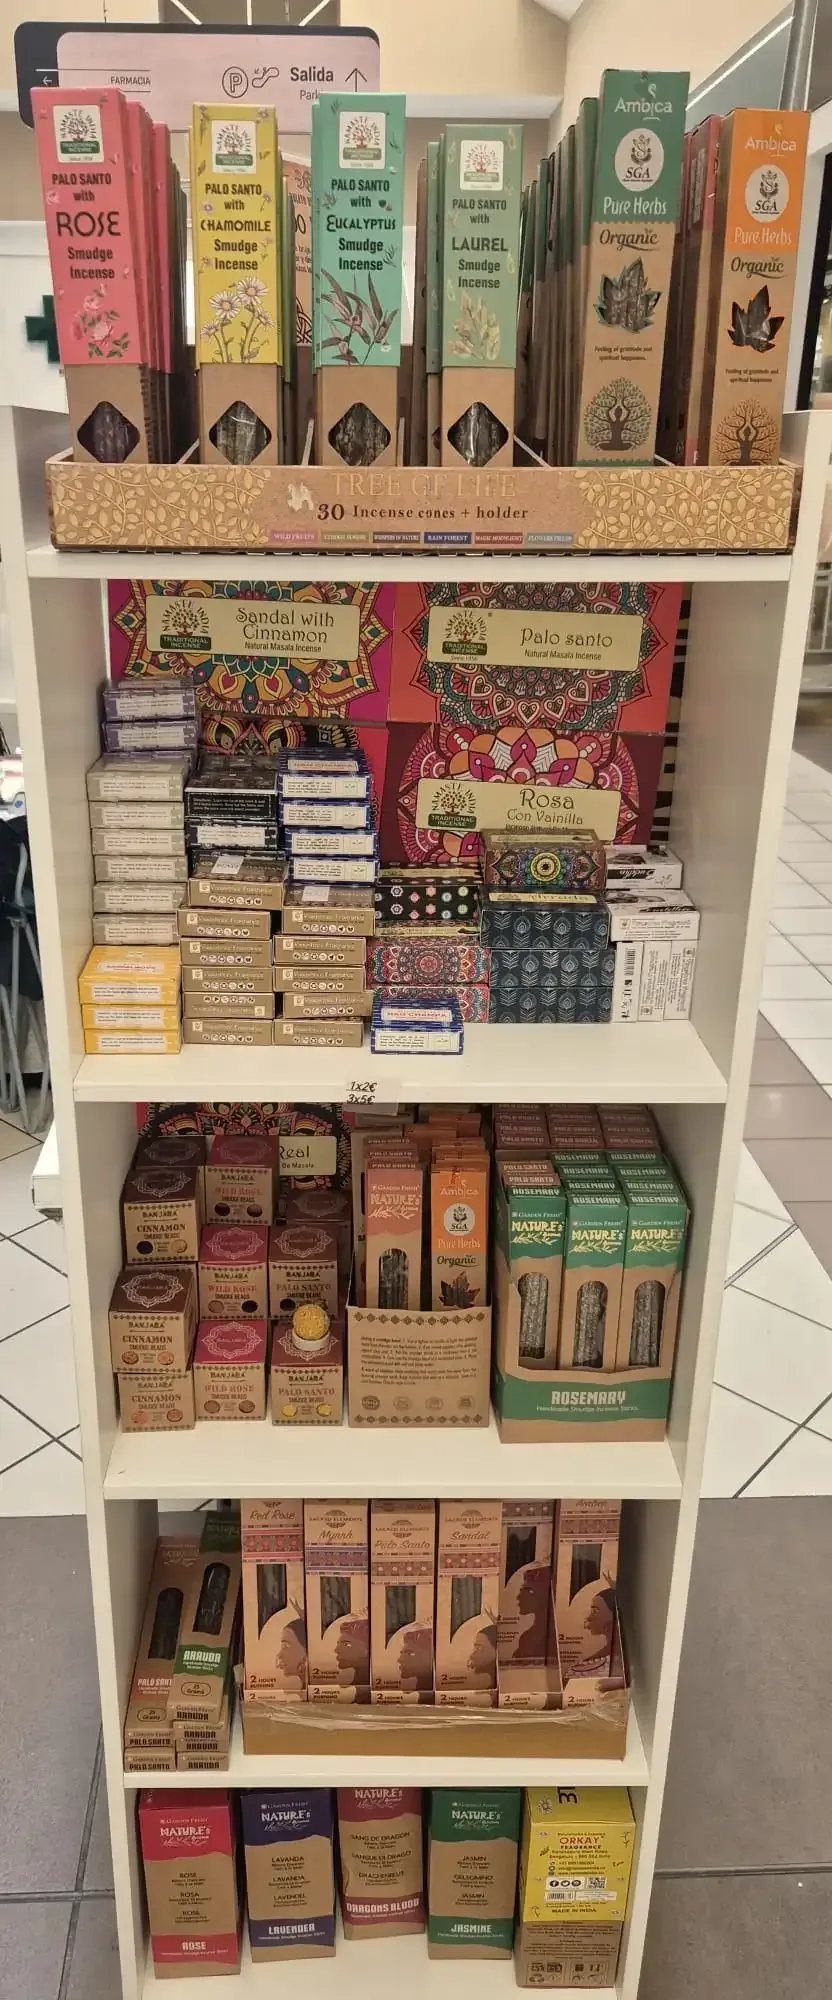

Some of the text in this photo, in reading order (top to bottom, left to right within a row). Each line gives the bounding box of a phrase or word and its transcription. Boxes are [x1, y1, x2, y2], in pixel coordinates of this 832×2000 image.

[290, 66, 334, 82] Salida
[111, 76, 151, 86] FARMACIA
[614, 97, 673, 116] Ambica
[744, 137, 796, 152] Ambica
[52, 172, 112, 185] PALO SANTO
[626, 166, 651, 179] SGA
[205, 183, 262, 195] PALO SANTO
[331, 179, 390, 193] PALO SANTO
[73, 187, 95, 201] with
[224, 199, 245, 211] with
[350, 195, 372, 208] with
[452, 198, 507, 211] PALO SANTO
[603, 196, 668, 216] Pure Herbs
[754, 200, 778, 212] SGA
[56, 211, 121, 237] ROSE
[326, 214, 396, 233] EUCALYPTUS
[470, 213, 490, 225] with
[201, 219, 271, 232] CHAMOMILE
[600, 229, 660, 251] Organic
[734, 227, 793, 246] Pure Herbs
[214, 238, 258, 255] Smudge
[338, 237, 383, 255] Smudge
[451, 237, 509, 252] LAUREL
[68, 246, 113, 262] Smudge
[215, 257, 258, 271] Incense
[339, 257, 383, 271] Incense
[458, 258, 501, 274] Smudge
[730, 257, 786, 279] Organic
[70, 266, 115, 280] Incense
[458, 276, 501, 289] Incense
[332, 471, 518, 498] TREE OF LIFE
[317, 503, 529, 520] 30 Incense cones holder
[161, 599, 193, 632] NAMASTE
[236, 607, 335, 627] Sandal with
[444, 610, 475, 639] NAMASTE
[243, 624, 328, 644] Cinnamon
[520, 627, 614, 648] Palo santo
[163, 636, 209, 645] TRADITIONAL
[171, 641, 204, 649] INCENSE
[244, 642, 323, 654] Natural Masala Incense
[524, 649, 602, 661] Natural Masala Incense
[432, 783, 464, 812] NAMASTE
[519, 787, 576, 810] Rosa
[432, 814, 475, 823] TRADITIONAL
[507, 808, 584, 826] Con Vainilla
[437, 820, 467, 828] INCENSE
[563, 1167, 609, 1176] ROSEMARY
[620, 1167, 667, 1177] ROSEMARY
[221, 1174, 256, 1182] BANJARA
[509, 1175, 528, 1184] PALO
[512, 1186, 560, 1197] ROSEMARY
[568, 1181, 616, 1190] ROSEMARY
[626, 1181, 674, 1191] ROSEMARY
[439, 1187, 478, 1197] Ambica
[572, 1195, 621, 1205] ROSEMARY
[630, 1194, 678, 1205] ROSEMARY
[142, 1210, 177, 1219] BANJARA
[136, 1224, 186, 1234] CINNAMON
[452, 1223, 468, 1232] SGA
[437, 1238, 481, 1252] Pure Herbs
[437, 1254, 476, 1271] Organic
[214, 1272, 249, 1280] BANJARA
[286, 1271, 321, 1279] BANJARA
[276, 1283, 333, 1291] PALO SANTO
[128, 1321, 166, 1329] BANJARA
[122, 1335, 173, 1344] CINNAMON
[210, 1371, 247, 1379] BANJARA
[137, 1381, 173, 1389] BANJARA
[278, 1387, 302, 1396] PALO
[131, 1394, 182, 1403] CINNAMON
[551, 1390, 627, 1406] ROSEMARY
[249, 1508, 297, 1521] Red Rose
[318, 1528, 353, 1542] Myrrh
[451, 1530, 492, 1542] Sandal
[375, 1540, 431, 1550] Palo Santo
[138, 1677, 155, 1688] PALO
[351, 1833, 369, 1842] SANG
[559, 1836, 599, 1845] ORKAY
[271, 1856, 304, 1864] LAVANDA
[463, 1855, 488, 1863] JASMIN
[273, 1875, 305, 1883] LAVANDA
[454, 1873, 494, 1882] GELSOMINO
[274, 1893, 306, 1902] LAVENDEL
[346, 1902, 389, 1914] DRAGONS
[391, 1898, 420, 1912] BLOOD
[268, 1923, 316, 1936] LAVENDER
[450, 1923, 493, 1934] JASMINE
[182, 1941, 207, 1952] ROSE
